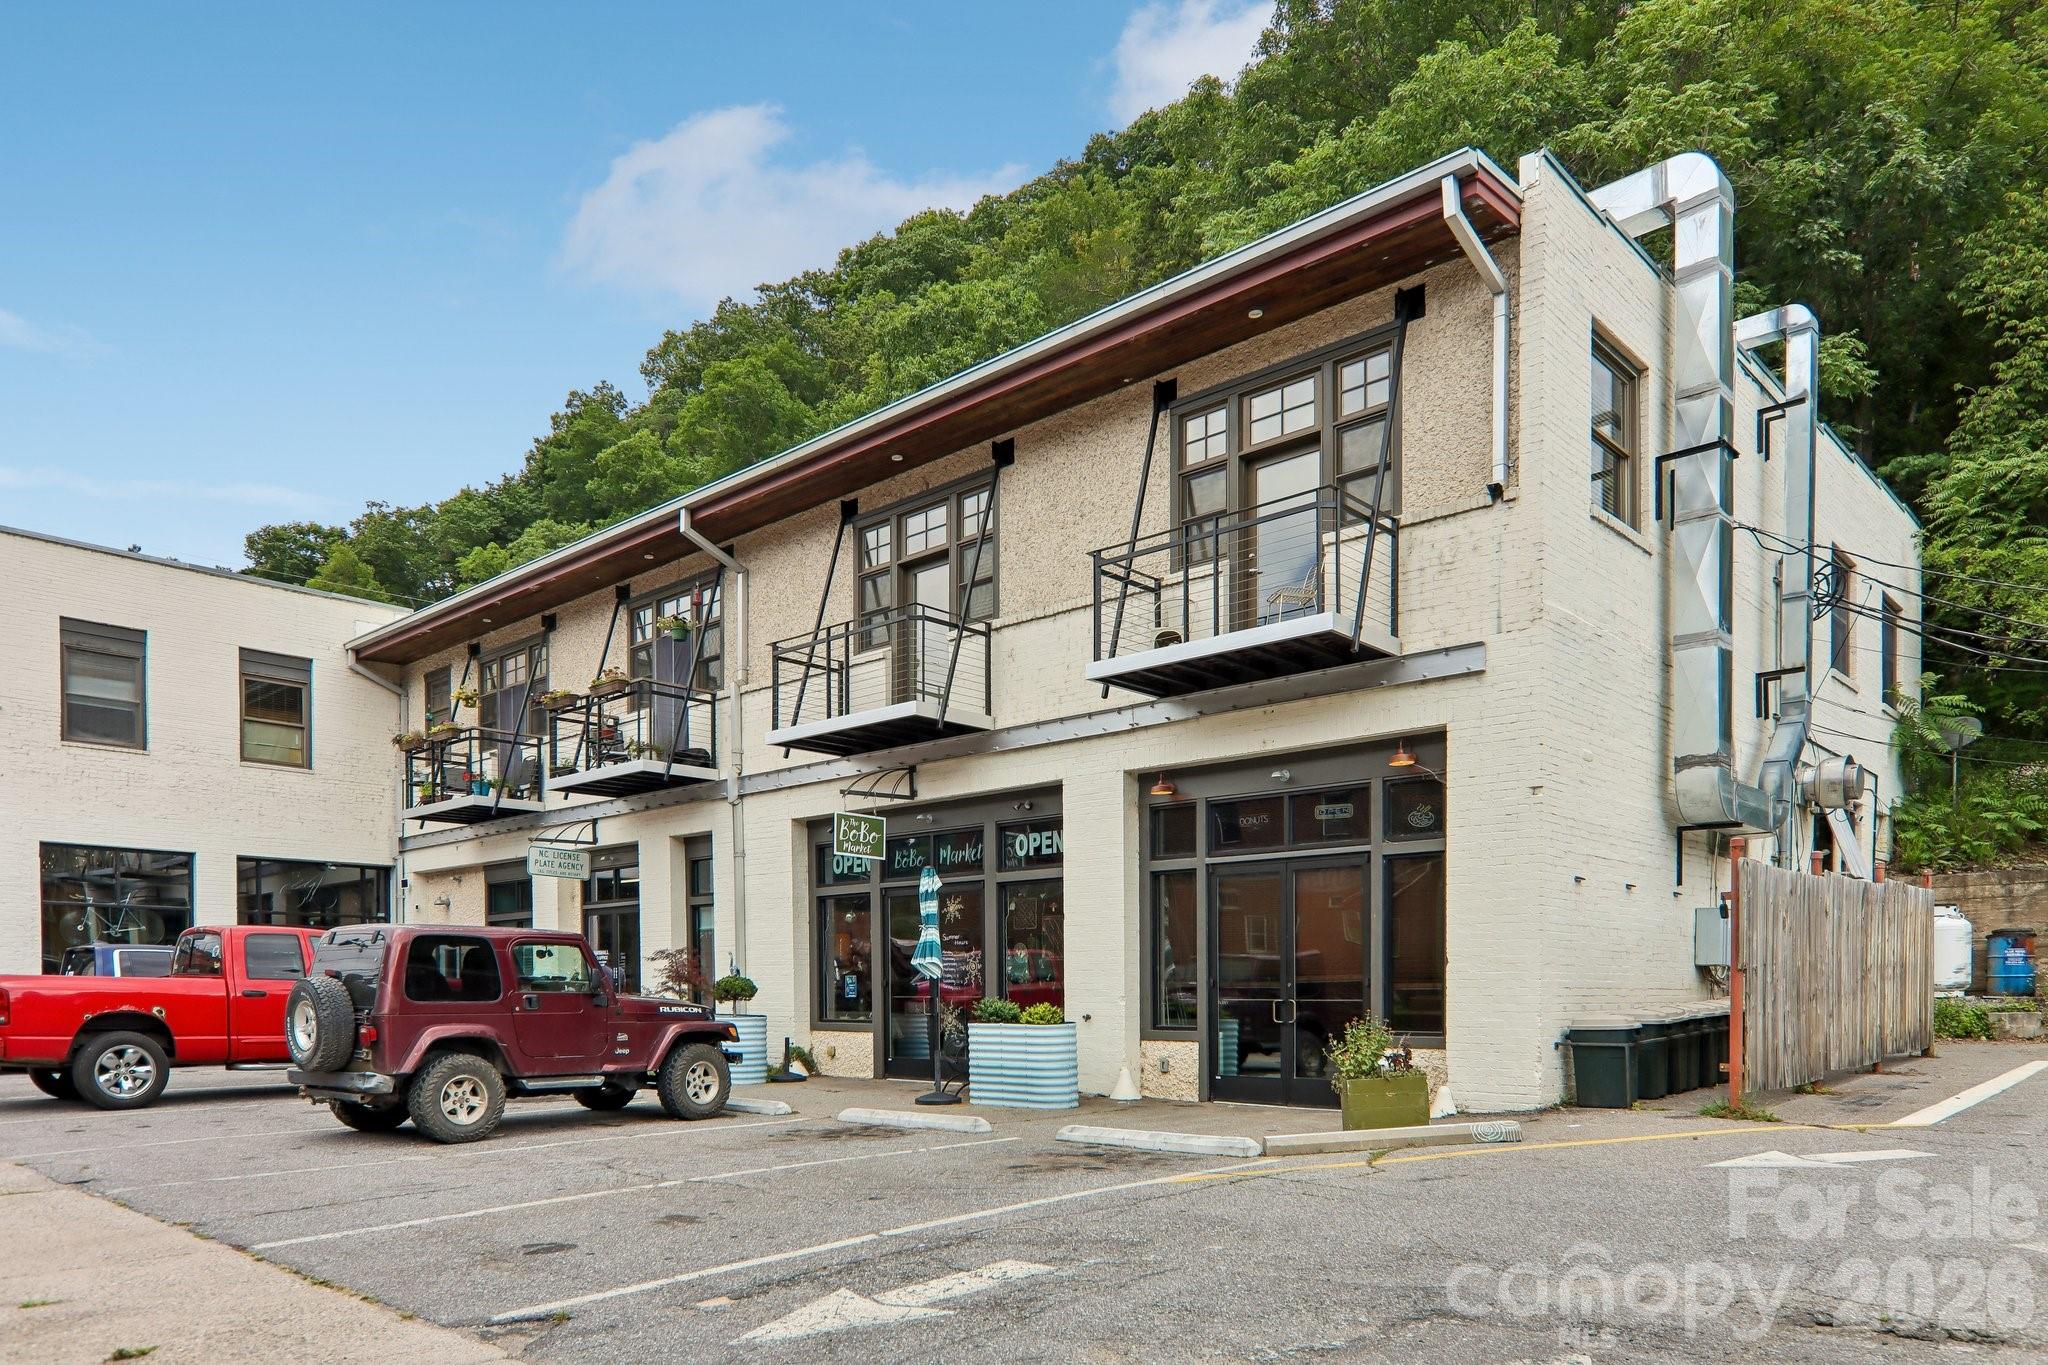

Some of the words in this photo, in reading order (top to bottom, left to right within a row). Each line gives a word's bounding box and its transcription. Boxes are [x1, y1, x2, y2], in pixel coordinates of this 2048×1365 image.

[840, 818, 882, 844] BoBo
[843, 840, 872, 855] Market
[1015, 830, 1064, 857] OPEN
[552, 851, 581, 862] LICENSE
[894, 848, 926, 869] BoBo
[940, 842, 985, 865] Market
[534, 859, 555, 869] PLATE
[558, 861, 584, 872] AGENCY
[833, 855, 871, 875] OPEN
[660, 1006, 703, 1014] RUBICON
